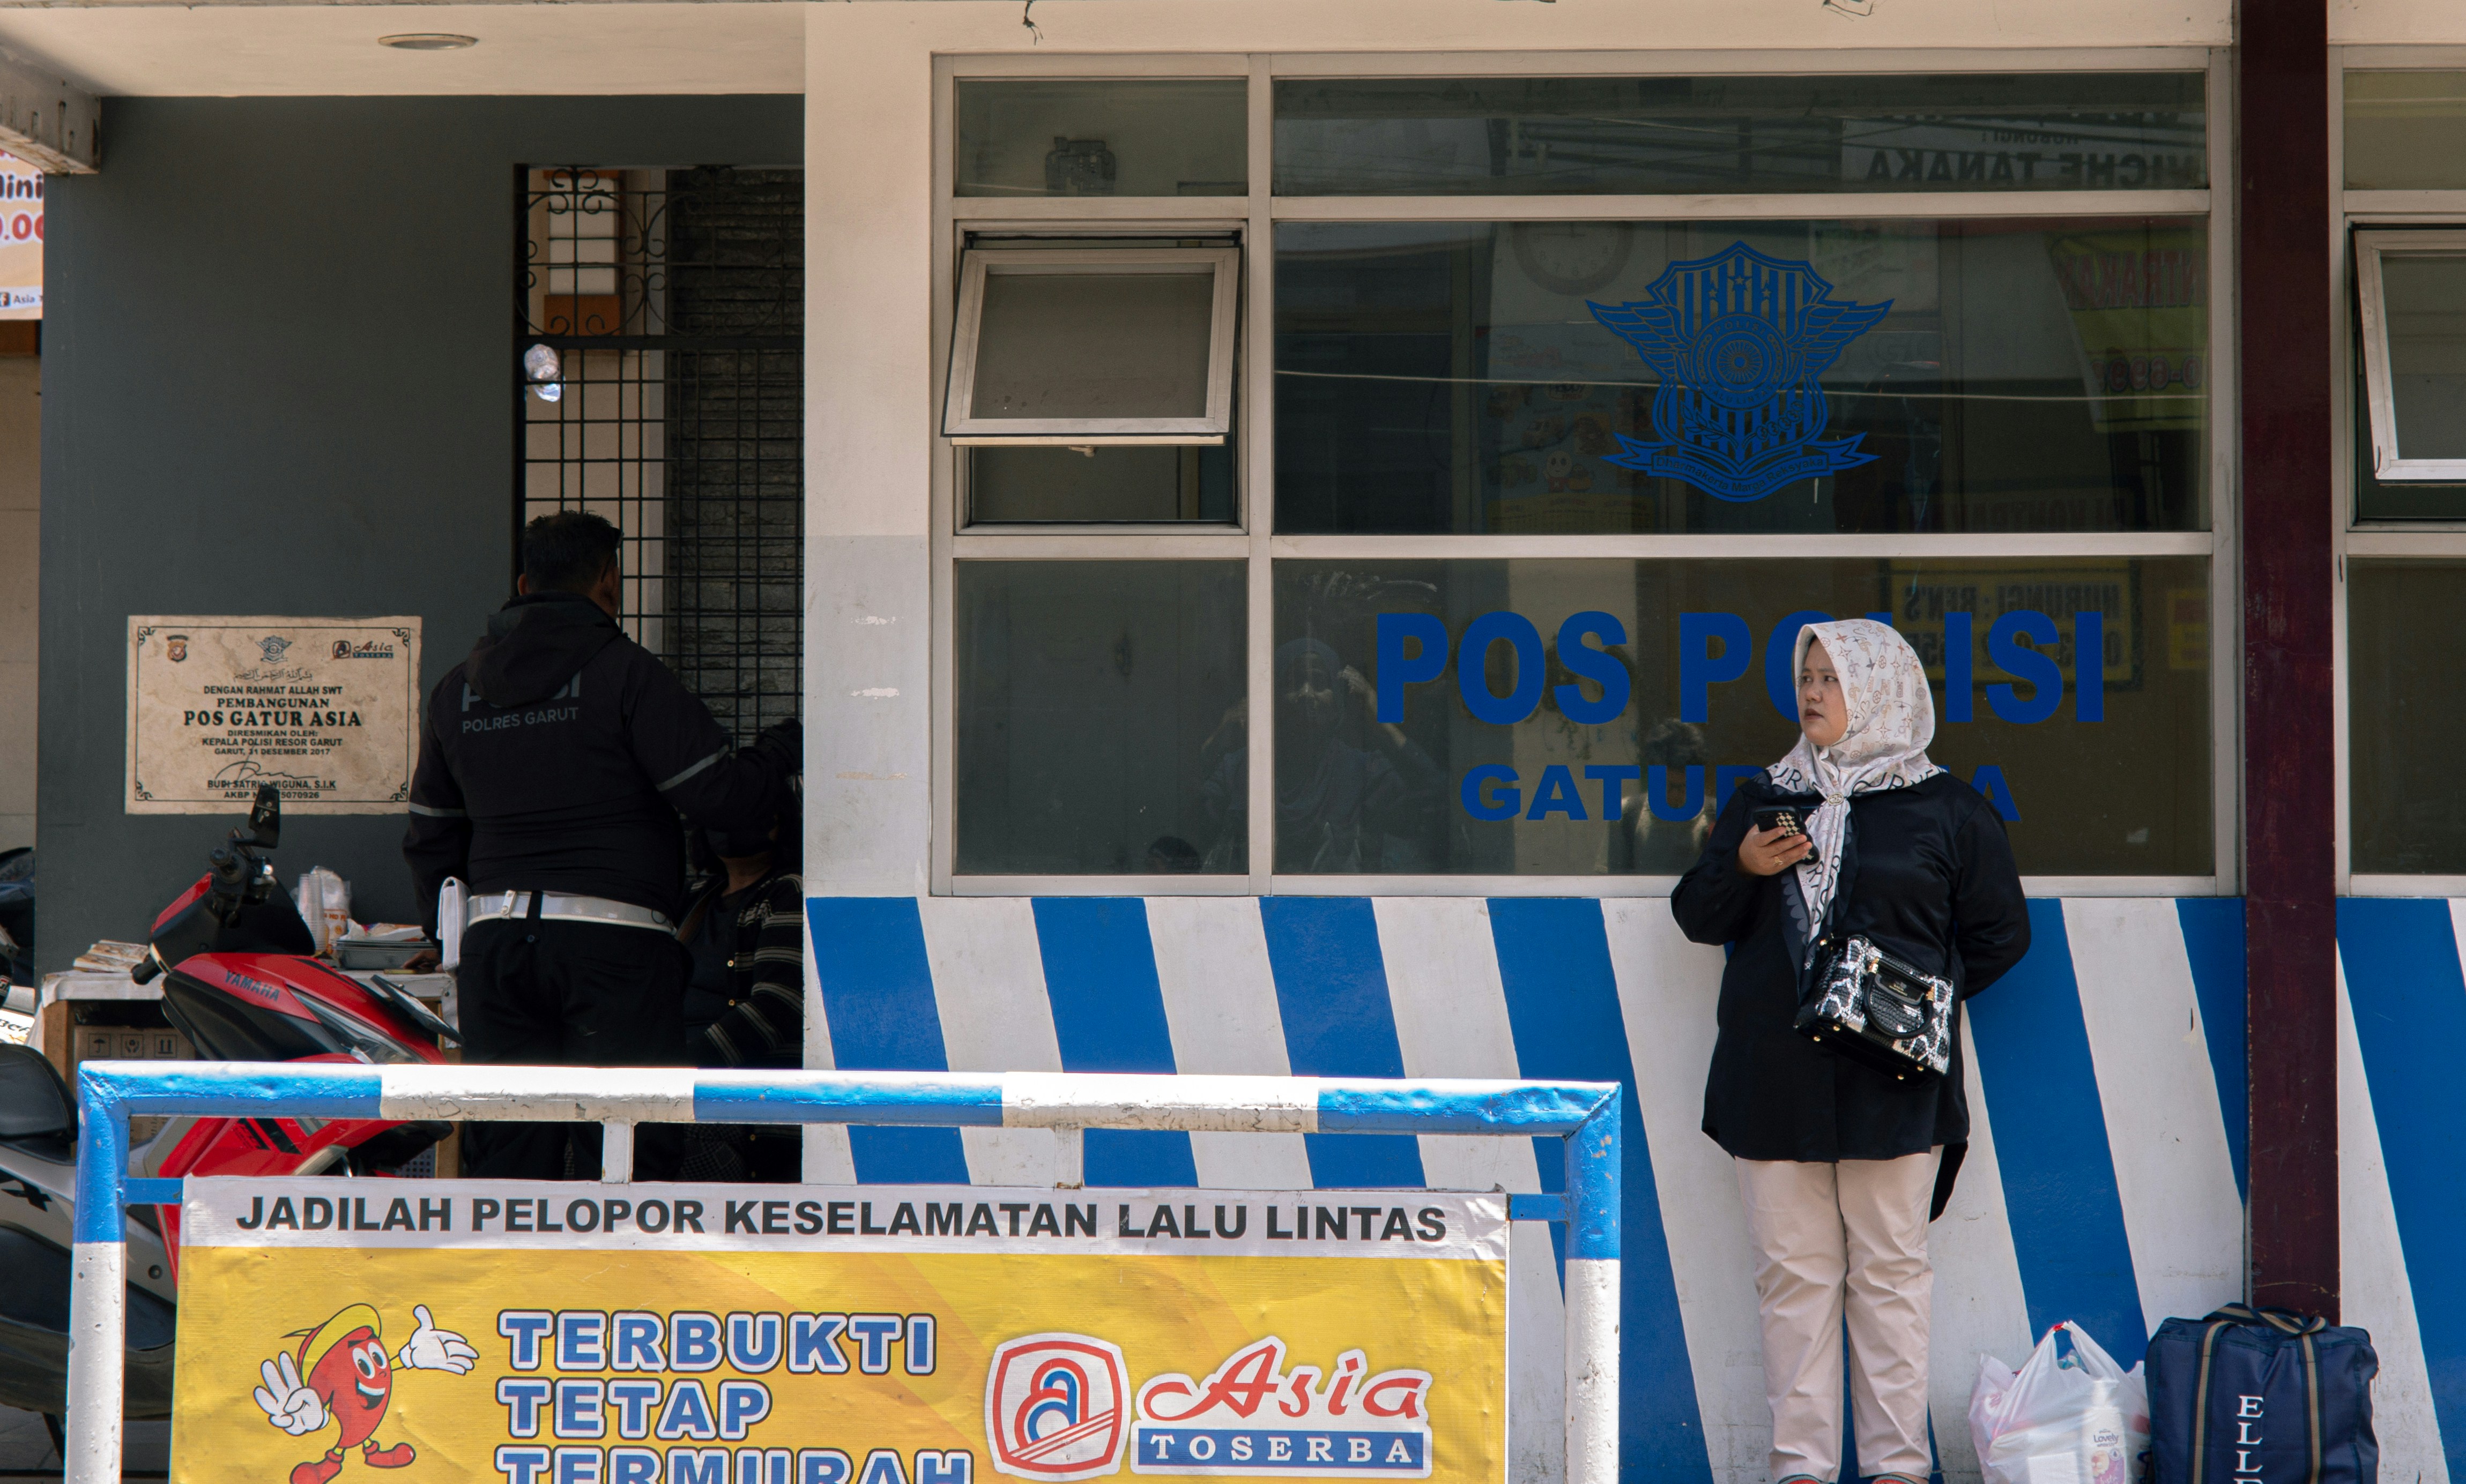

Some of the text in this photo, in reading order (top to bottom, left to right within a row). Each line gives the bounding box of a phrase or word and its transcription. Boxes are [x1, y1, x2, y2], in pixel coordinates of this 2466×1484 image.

[13, 295, 34, 303] Asia
[1714, 320, 1767, 335] POLISI
[1731, 475, 1767, 494] Marga
[1377, 610, 1631, 725] POS
[1680, 610, 2104, 725] PISI
[204, 685, 343, 695] DENGAN RAHMAT ALLAH SWT
[217, 698, 329, 709] PEMBANGUNAN
[184, 710, 362, 727] POS GATUR ASIA
[462, 706, 579, 734] POLRES GARUT
[227, 729, 318, 737] DIRESMIKAN OLEH:
[202, 738, 343, 747] KEPALA POLISI RESOR GARUT
[214, 748, 246, 756] GARUT,
[261, 748, 308, 756] DESEMBER
[310, 748, 331, 756] 2017
[207, 780, 231, 789] BUDI
[314, 780, 337, 789] S.I.K
[225, 969, 280, 1002] YAMAHA
[236, 1196, 1447, 1242] JADILAH PELOPOR KESELAMATAN LALU LINTAS
[499, 1310, 937, 1375] TERBUKTI
[1143, 1344, 1425, 1422] Asia
[496, 1377, 772, 1441] TETAP
[2093, 1432, 2119, 1445] Lovely
[1149, 1434, 1413, 1464] TOSERBA
